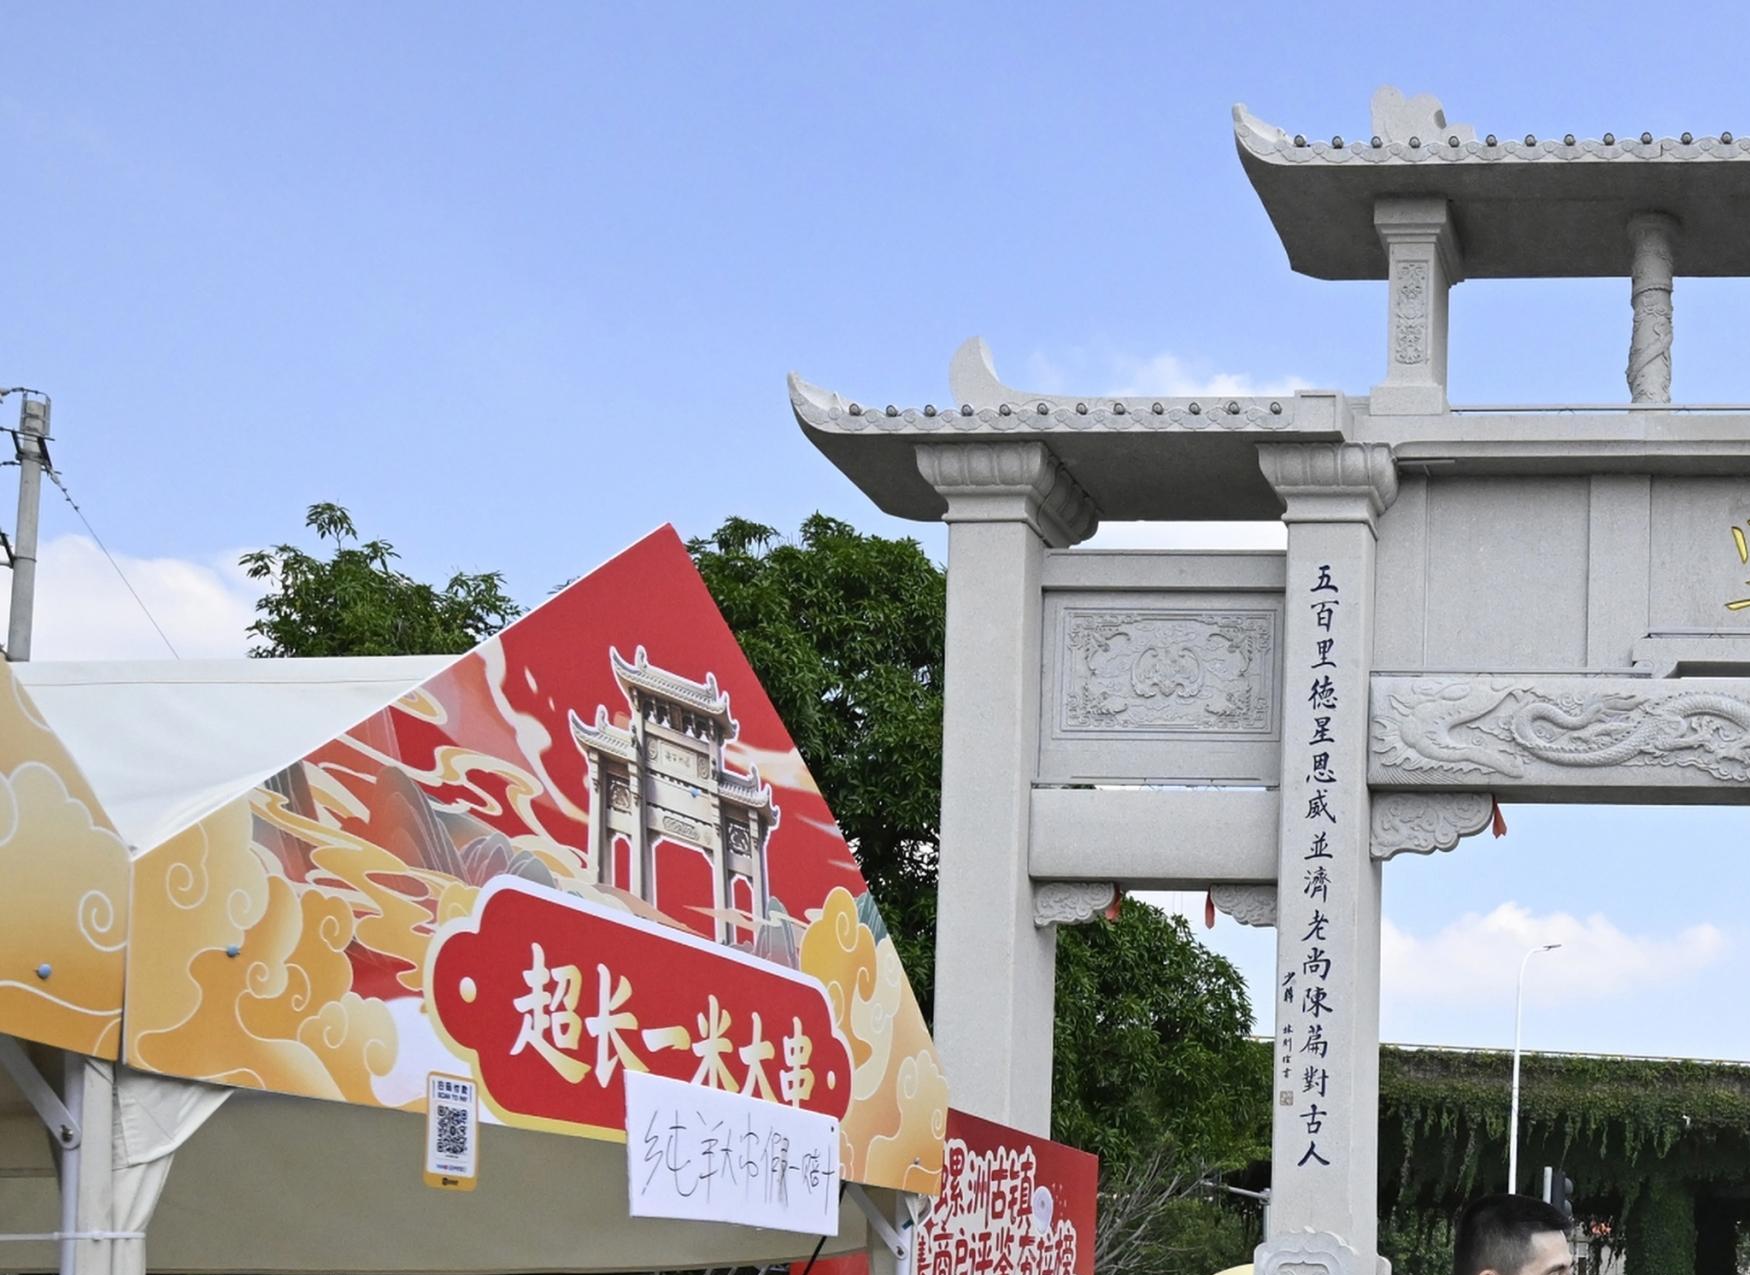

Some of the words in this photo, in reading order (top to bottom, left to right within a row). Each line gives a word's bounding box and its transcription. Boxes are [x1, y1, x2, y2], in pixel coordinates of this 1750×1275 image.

[509, 942, 815, 1110] 超长一米大串
